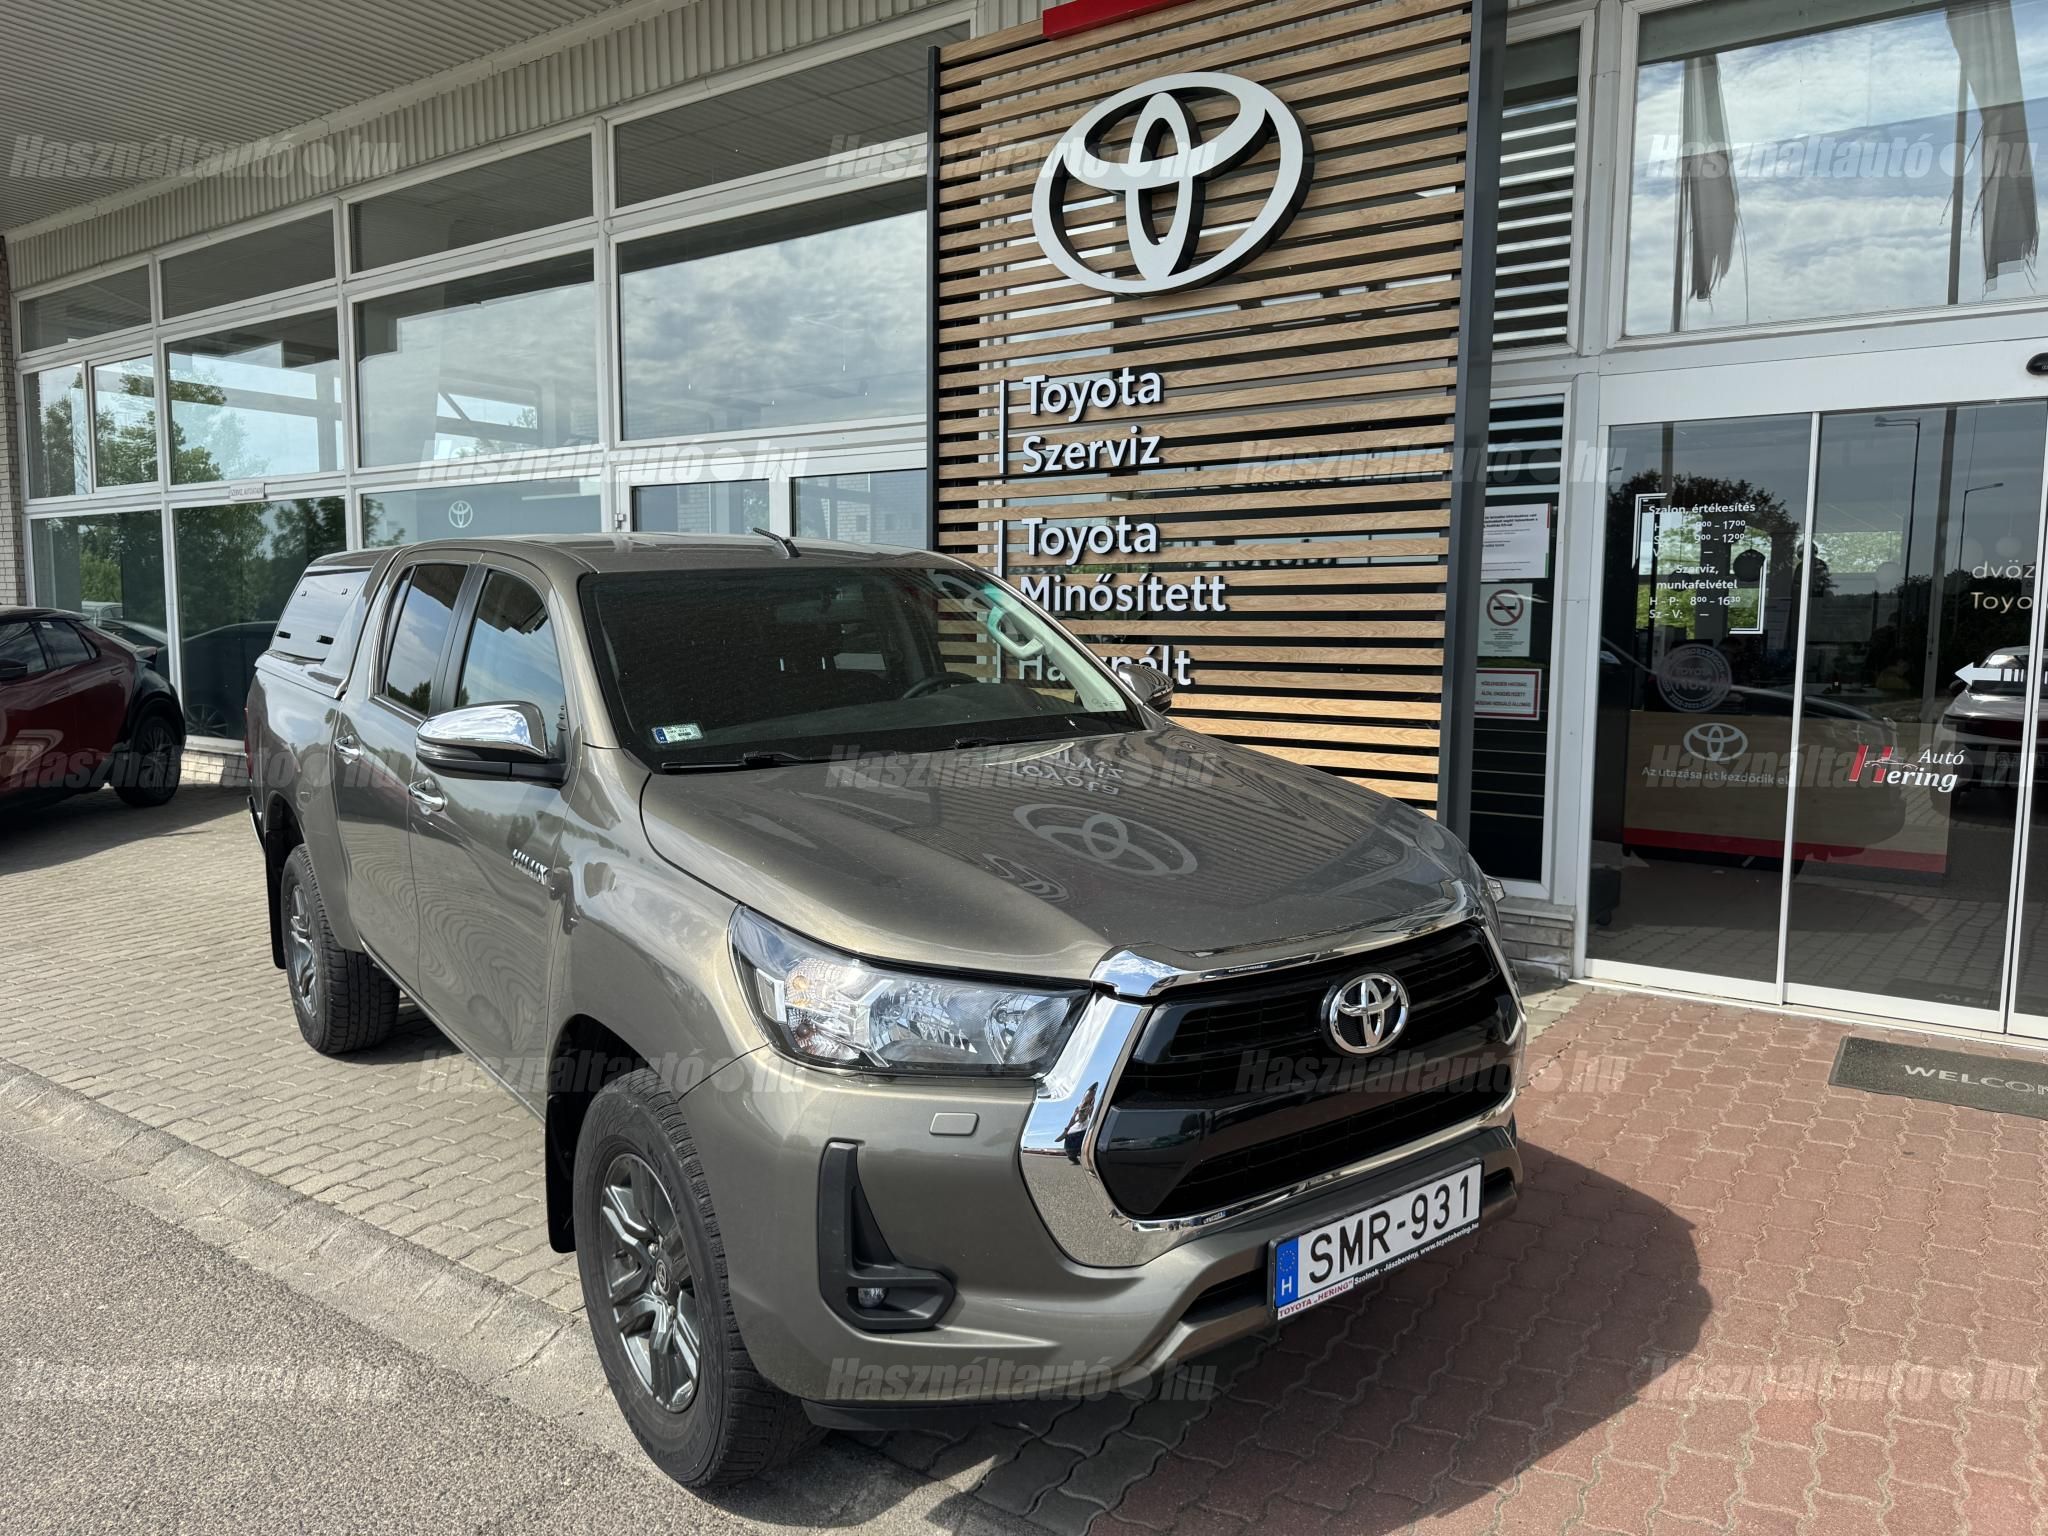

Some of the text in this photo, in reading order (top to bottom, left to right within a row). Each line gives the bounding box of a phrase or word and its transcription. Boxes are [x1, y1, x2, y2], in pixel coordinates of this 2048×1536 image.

[1022, 366, 1164, 421] Toyota
[1022, 425, 1163, 473] Szerviz
[1692, 503, 1756, 514] értékesítés
[1020, 515, 1159, 565] Toyota
[1020, 573, 1229, 612] Minősített
[1656, 579, 1737, 589] munkafelvétel
[1642, 767, 1657, 777] Az
[1659, 768, 1702, 780] utazása
[1705, 771, 1719, 781] itt
[1720, 771, 1775, 785] kezdődik
[1848, 744, 1958, 793] Hering
[1918, 748, 1966, 766] Autó
[1309, 1174, 1469, 1284] SMR-931
[1279, 1298, 1312, 1317] TOYOTA
[1354, 1269, 1380, 1285] Szolnok
[1281, 1276, 1292, 1296] H
